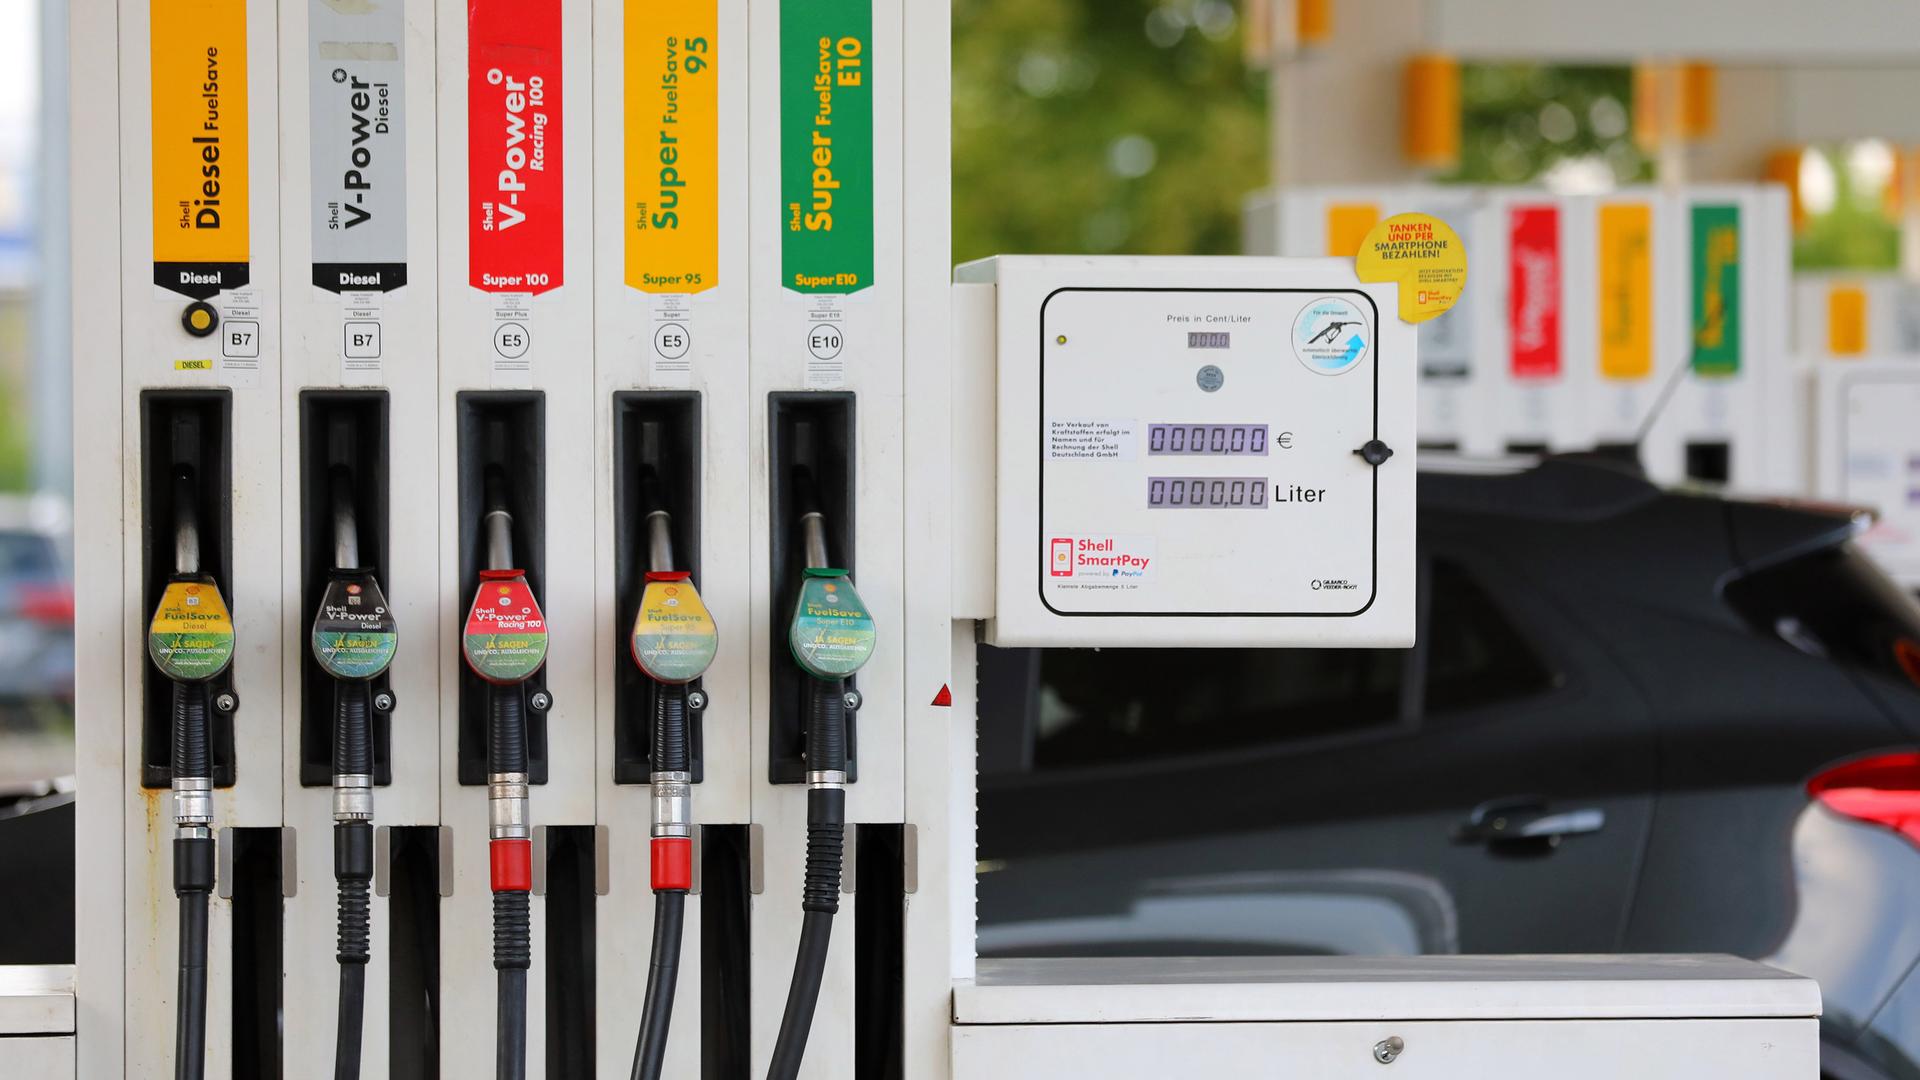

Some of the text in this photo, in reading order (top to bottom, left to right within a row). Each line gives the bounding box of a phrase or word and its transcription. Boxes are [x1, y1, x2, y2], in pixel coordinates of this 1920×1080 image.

[684, 36, 708, 75] 95
[837, 36, 862, 86] E10
[374, 83, 389, 134] Diesel
[529, 76, 548, 171] Racing 100
[193, 46, 220, 230] Diesel FuelSave
[652, 36, 686, 230] Super FuelSave
[804, 36, 840, 231] Super FuelSave
[344, 75, 371, 230] V-Power
[499, 75, 526, 231] V-Power
[180, 200, 190, 229] Shell
[328, 201, 339, 230] Shell
[483, 202, 493, 231] Shell
[637, 202, 647, 230] Shell
[790, 202, 801, 231] Shell
[1389, 223, 1432, 233] TANKEN
[1388, 232, 1434, 242] UND PER
[1375, 240, 1448, 252] SMARTPHONE
[1382, 249, 1440, 260] BEZAHLEN!
[180, 271, 222, 284] Diesel
[340, 272, 381, 285] Diesel
[482, 273, 549, 288] Super 100
[643, 273, 702, 286] Super 95
[795, 273, 857, 288] Super E10
[1166, 315, 1252, 323] Preis in Cent/Liter
[231, 333, 251, 346] B7
[353, 334, 373, 347] B7
[502, 334, 522, 347] E5
[663, 335, 682, 348] E5
[812, 336, 839, 349] E10
[182, 361, 205, 369] DIESEL
[1277, 431, 1293, 449] €
[1275, 485, 1326, 503] Liter
[1079, 539, 1113, 551] Shell
[1078, 554, 1150, 570] SmartPay
[164, 612, 221, 621] FuelSave
[327, 612, 382, 621] V-Power
[476, 614, 527, 622] V-Power
[647, 613, 702, 622] FuelSave
[807, 607, 861, 617] FuelSave
[183, 621, 208, 630] Diesel
[361, 621, 382, 630] Diesel
[498, 620, 541, 630] Racing 100
